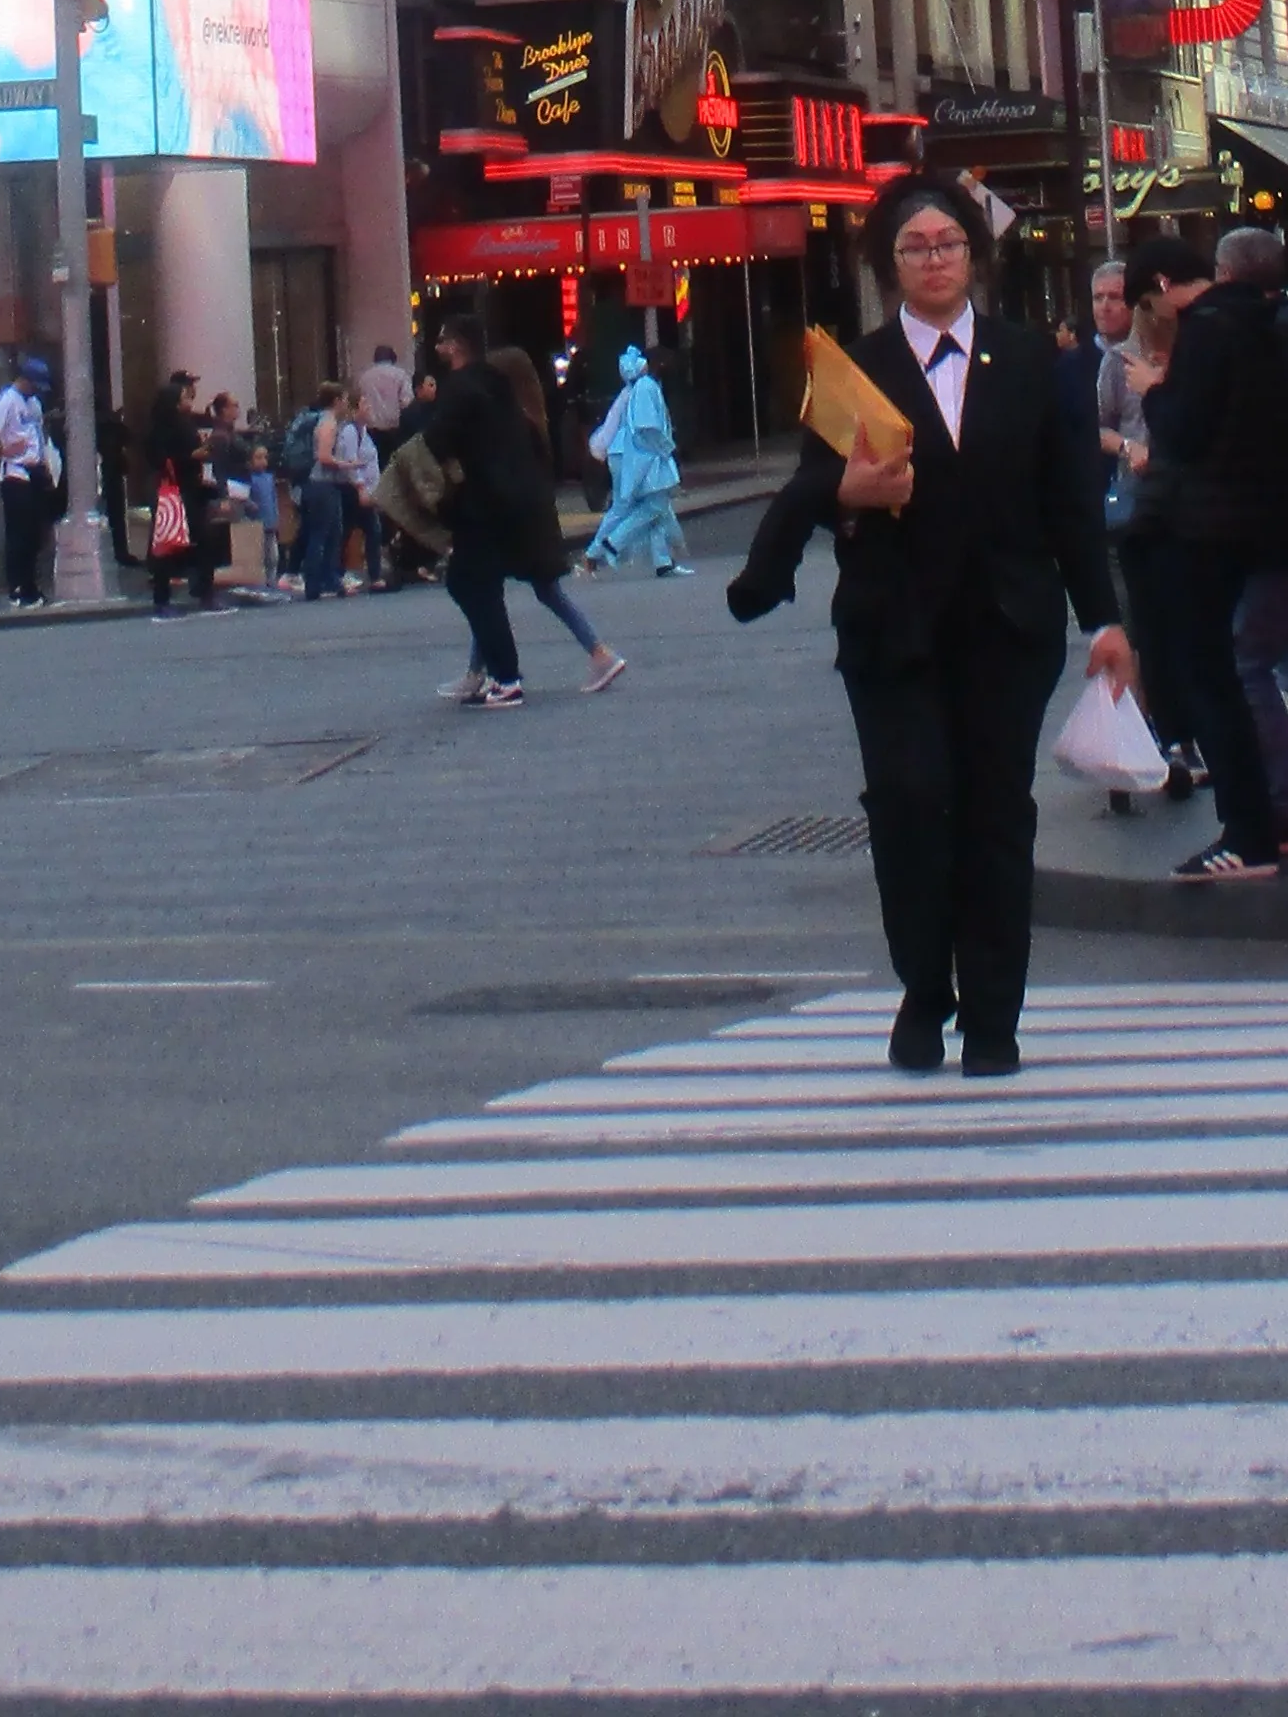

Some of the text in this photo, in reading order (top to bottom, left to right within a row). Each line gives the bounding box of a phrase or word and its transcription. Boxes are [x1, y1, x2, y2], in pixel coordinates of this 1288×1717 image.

[520, 30, 593, 69] Brooklyn
[542, 54, 590, 83] Diner
[537, 90, 581, 125] Cafe
[574, 225, 676, 253] DINR
